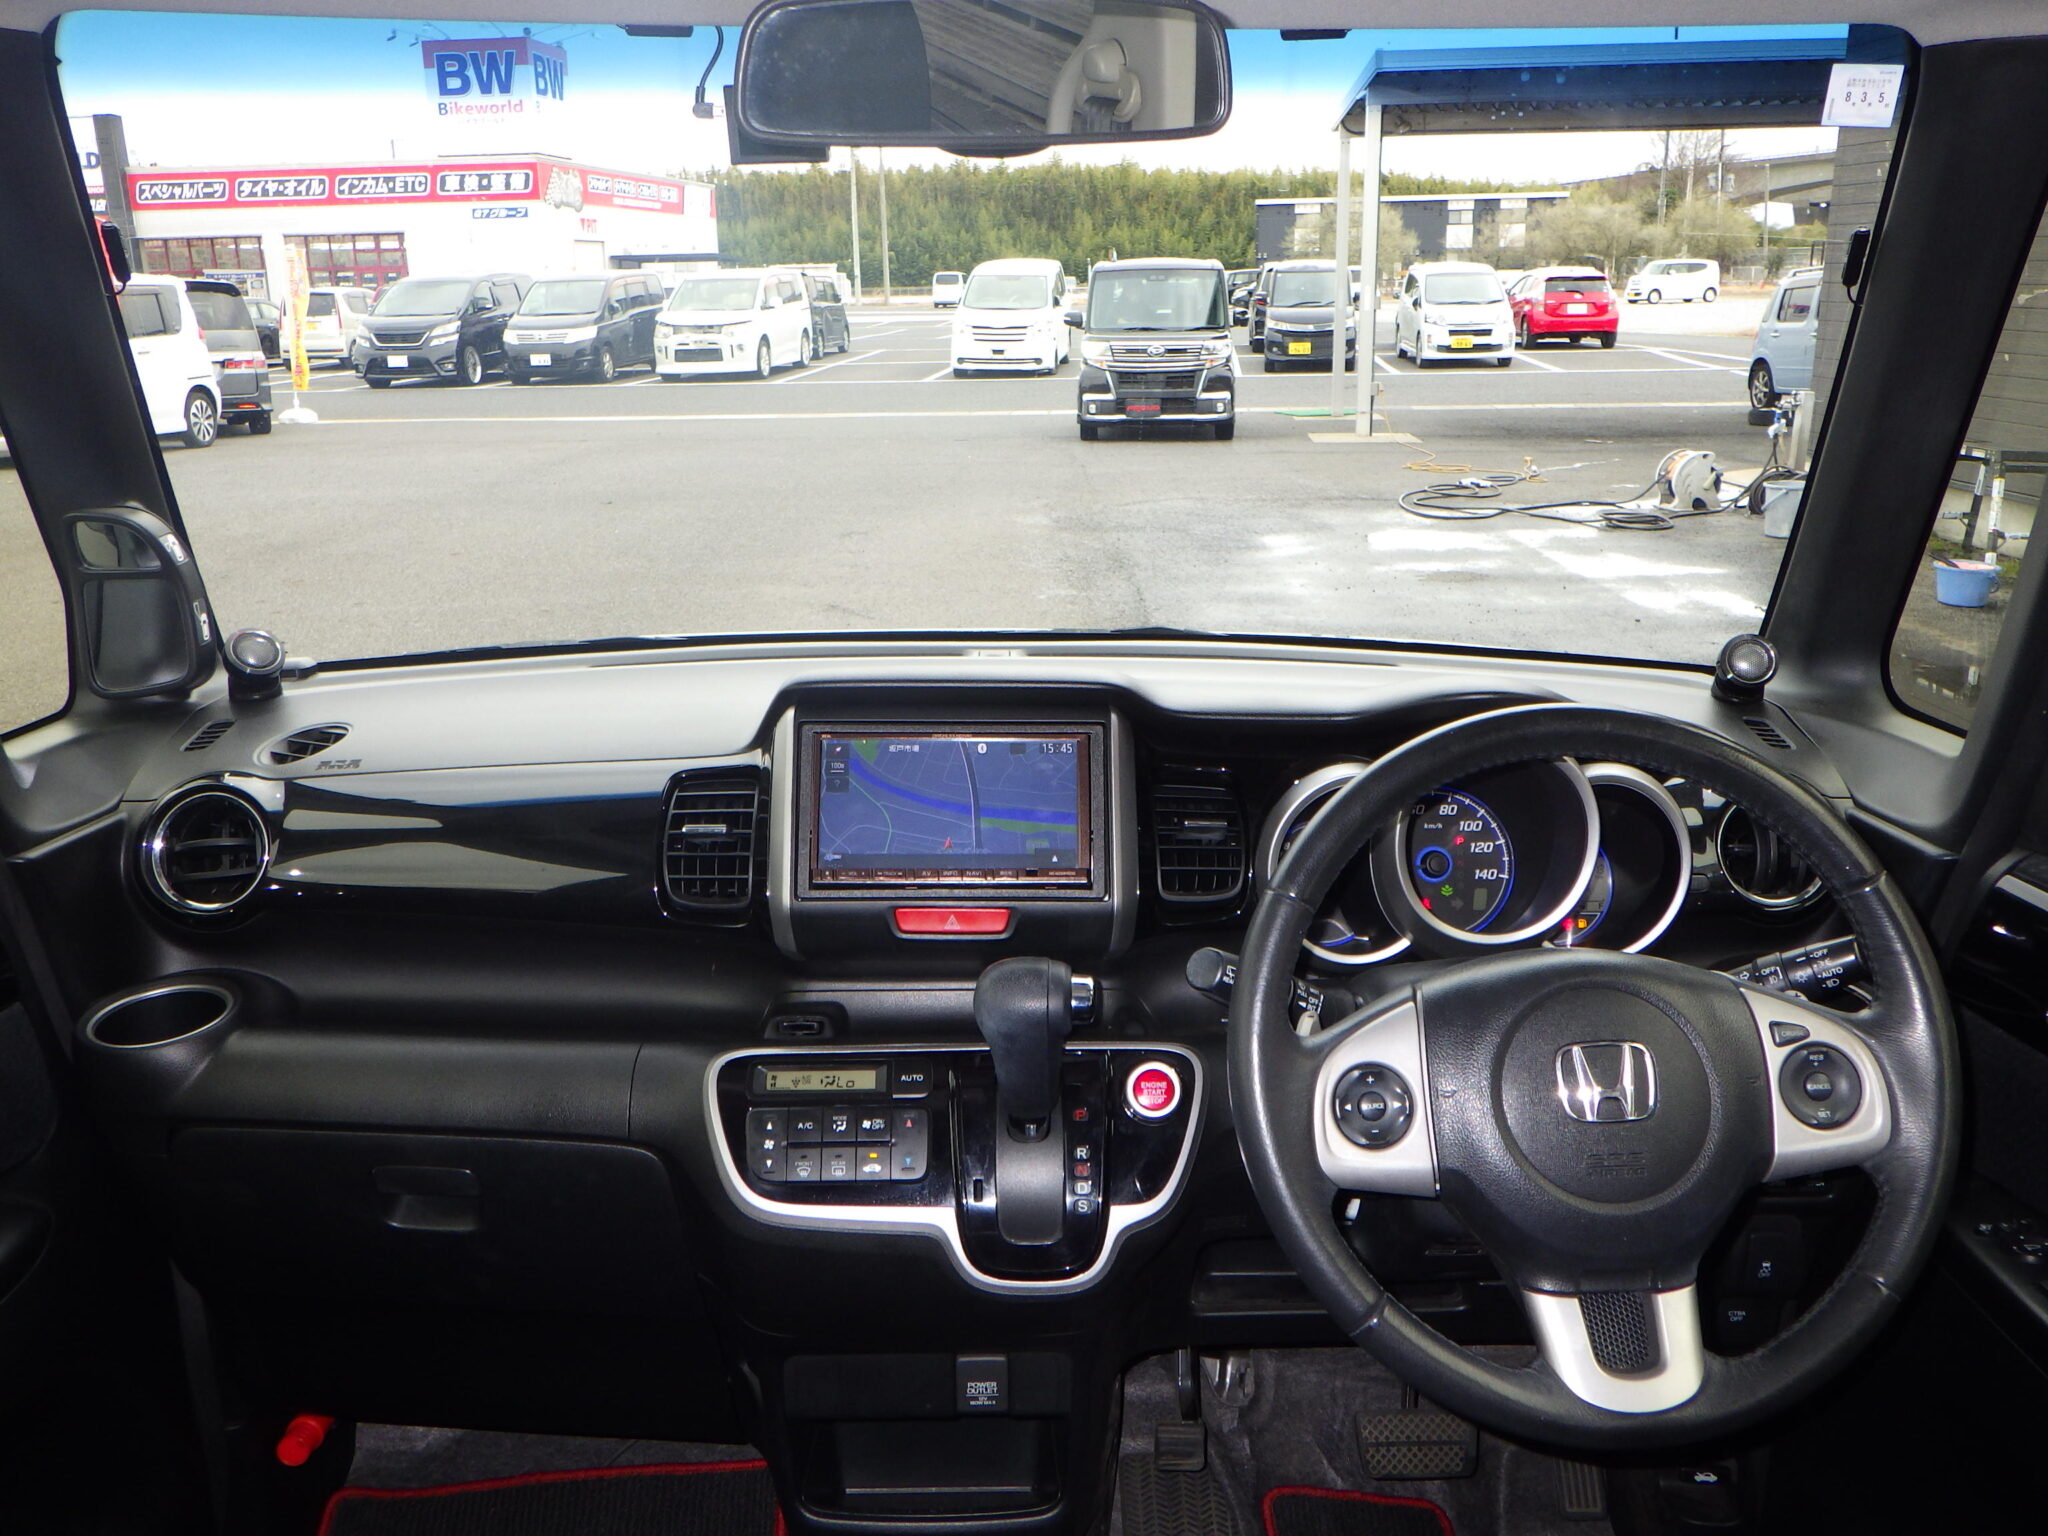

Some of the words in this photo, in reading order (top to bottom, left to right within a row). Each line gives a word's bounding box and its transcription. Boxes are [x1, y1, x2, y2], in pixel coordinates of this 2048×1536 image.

[435, 50, 515, 97] BW
[532, 52, 564, 101] BW
[438, 100, 524, 116] Bikeworld
[140, 181, 225, 200] スペシャルパーツ
[238, 177, 325, 198] タイヤ・オイル
[338, 174, 426, 195] インカム・ETC
[1042, 742, 1073, 754] 15:45
[1439, 804, 1457, 816] 80
[1423, 822, 1443, 830] km/h
[1459, 820, 1482, 832] 100
[1470, 841, 1493, 853] 120
[1474, 868, 1498, 880] 140
[1822, 966, 1844, 978] AUTO
[900, 1074, 924, 1082] AUTO
[1140, 1081, 1167, 1089] ENGINE
[1143, 1088, 1165, 1096] START
[797, 1122, 813, 1130] A/C
[1076, 1148, 1087, 1159] R
[1077, 1182, 1089, 1194] D
[1077, 1200, 1088, 1212] S
